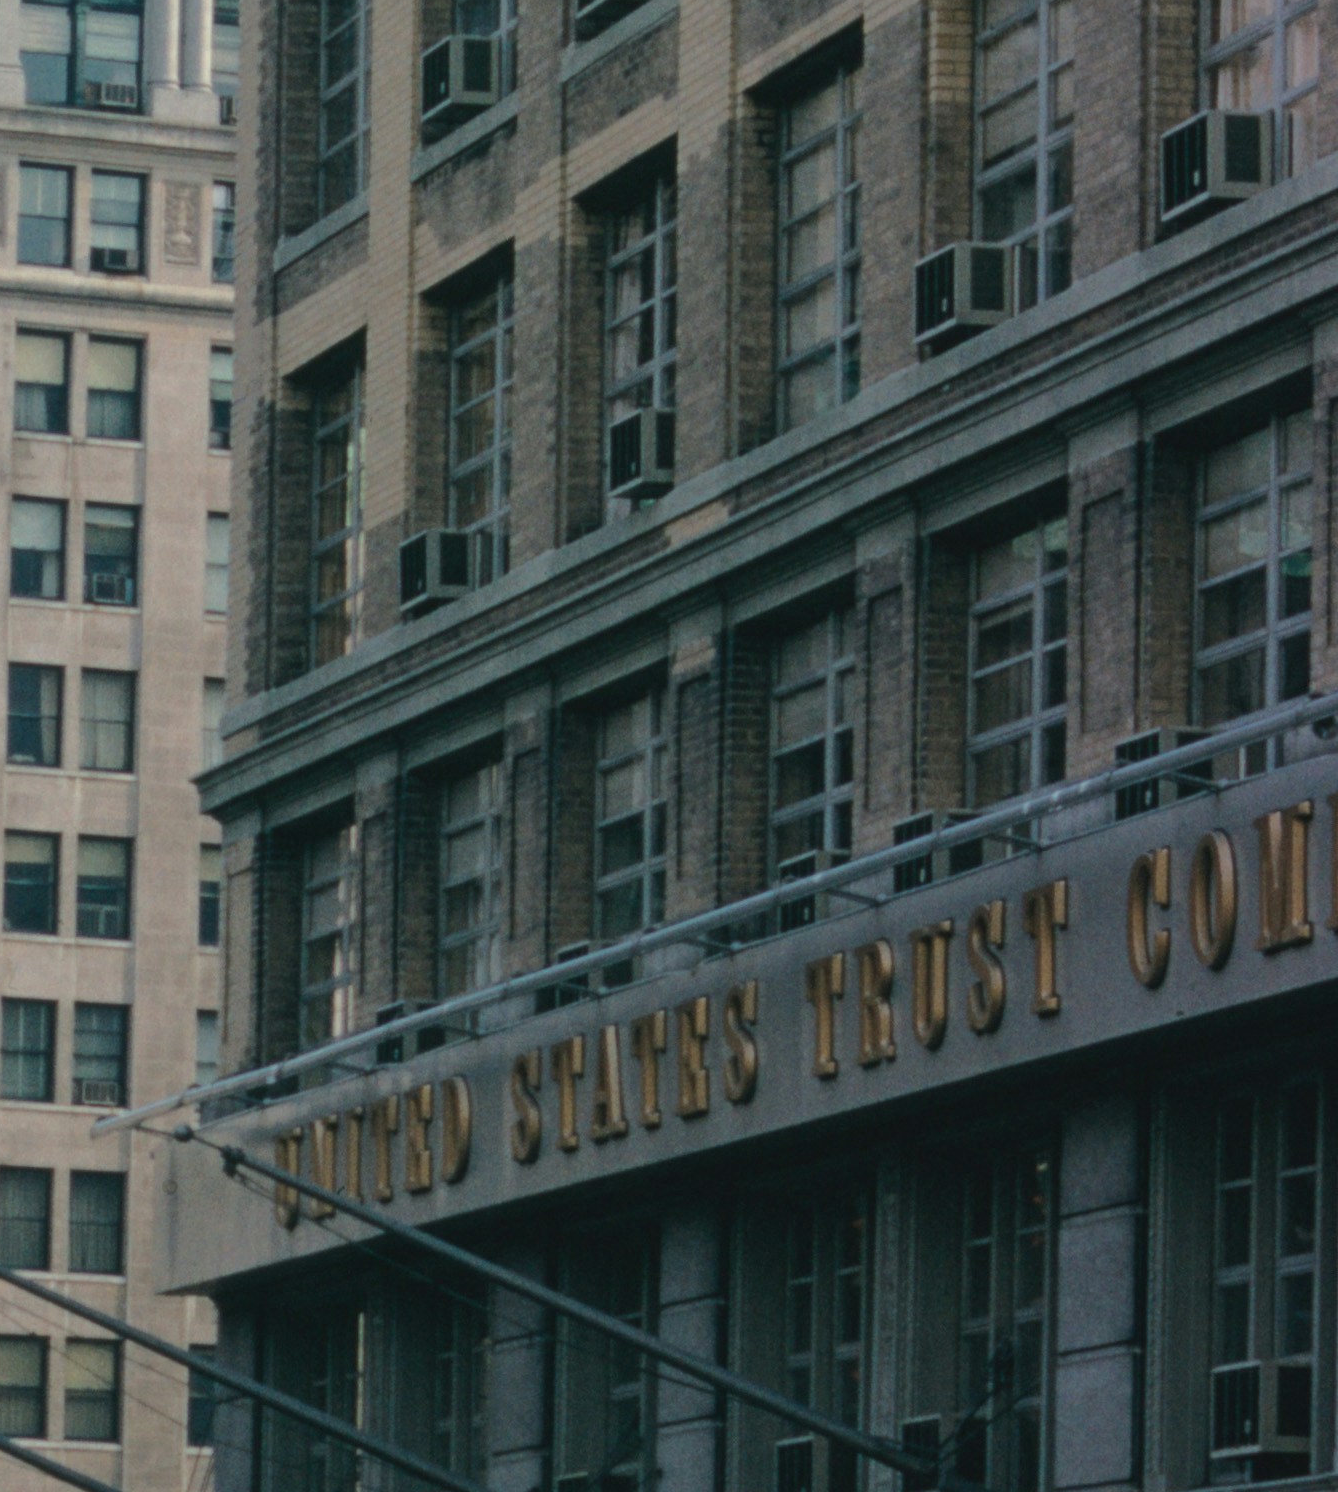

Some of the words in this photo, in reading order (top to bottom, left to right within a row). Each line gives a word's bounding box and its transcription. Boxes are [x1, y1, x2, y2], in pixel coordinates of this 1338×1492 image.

[274, 1075, 471, 1232] UNITED
[510, 977, 760, 1166] STATES
[806, 878, 1071, 1080] TRUST
[1128, 792, 1338, 990] COM
